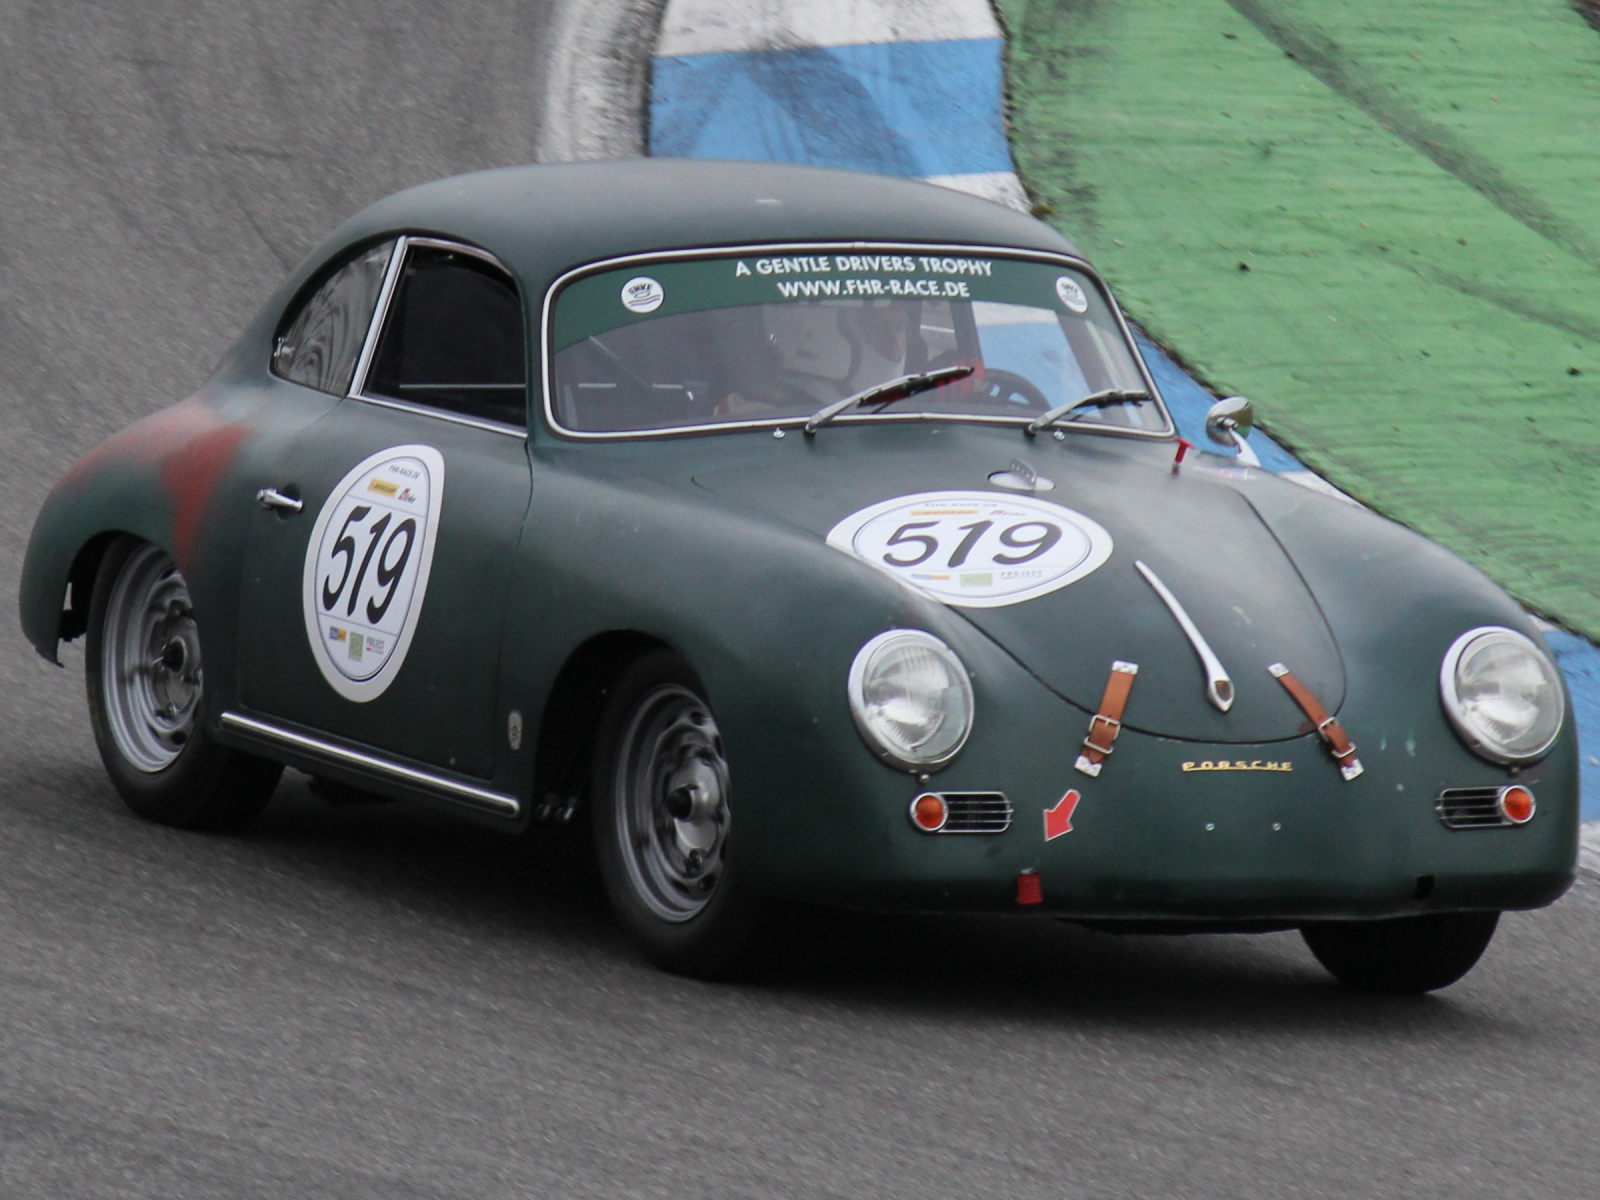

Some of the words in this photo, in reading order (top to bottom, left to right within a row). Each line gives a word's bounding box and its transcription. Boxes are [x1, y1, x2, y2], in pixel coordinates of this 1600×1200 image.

[735, 260, 751, 277] A
[756, 256, 831, 275] GENTLE
[835, 256, 916, 272] DRIVERS
[919, 257, 992, 276] TROPHY
[777, 279, 970, 298] WWW.FHR-RACE.DE
[883, 519, 1063, 569] 519
[322, 505, 417, 625] 519
[1181, 760, 1294, 772] PORSCHE
